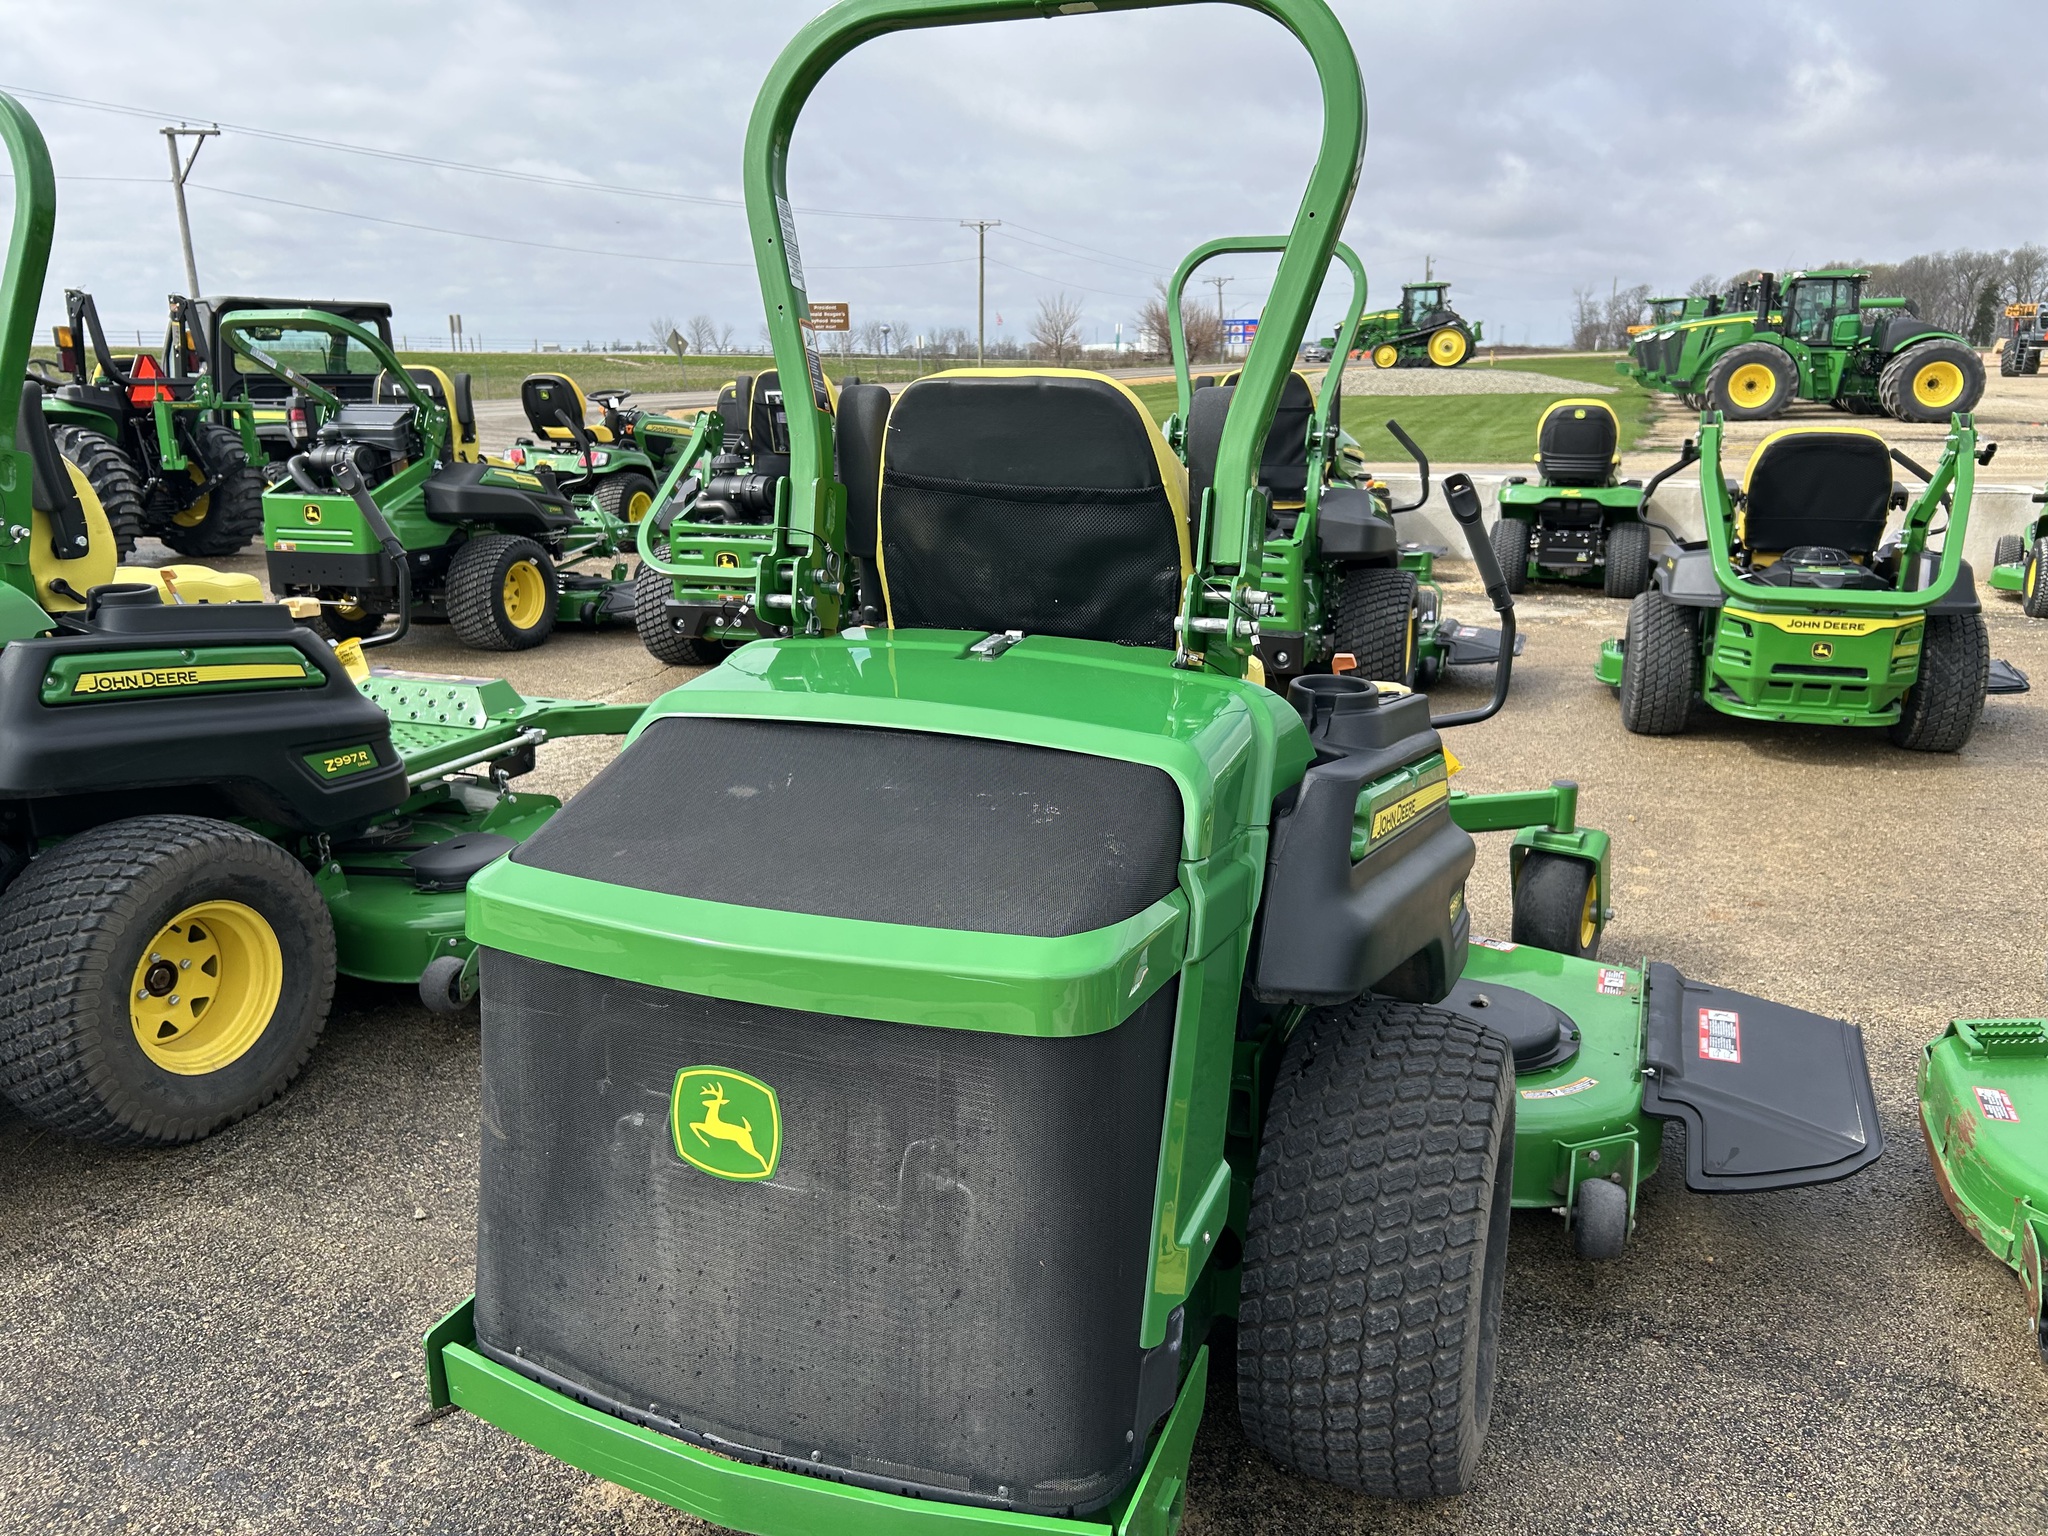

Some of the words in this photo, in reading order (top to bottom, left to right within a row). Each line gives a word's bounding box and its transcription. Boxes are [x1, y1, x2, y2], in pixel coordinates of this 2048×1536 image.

[1787, 619, 1820, 629] JOHN
[1823, 620, 1865, 631] DEERE
[88, 675, 138, 691] JOHN
[141, 671, 199, 686] DEERE
[1377, 810, 1399, 838] JOHN
[1397, 799, 1416, 823] DEERE
